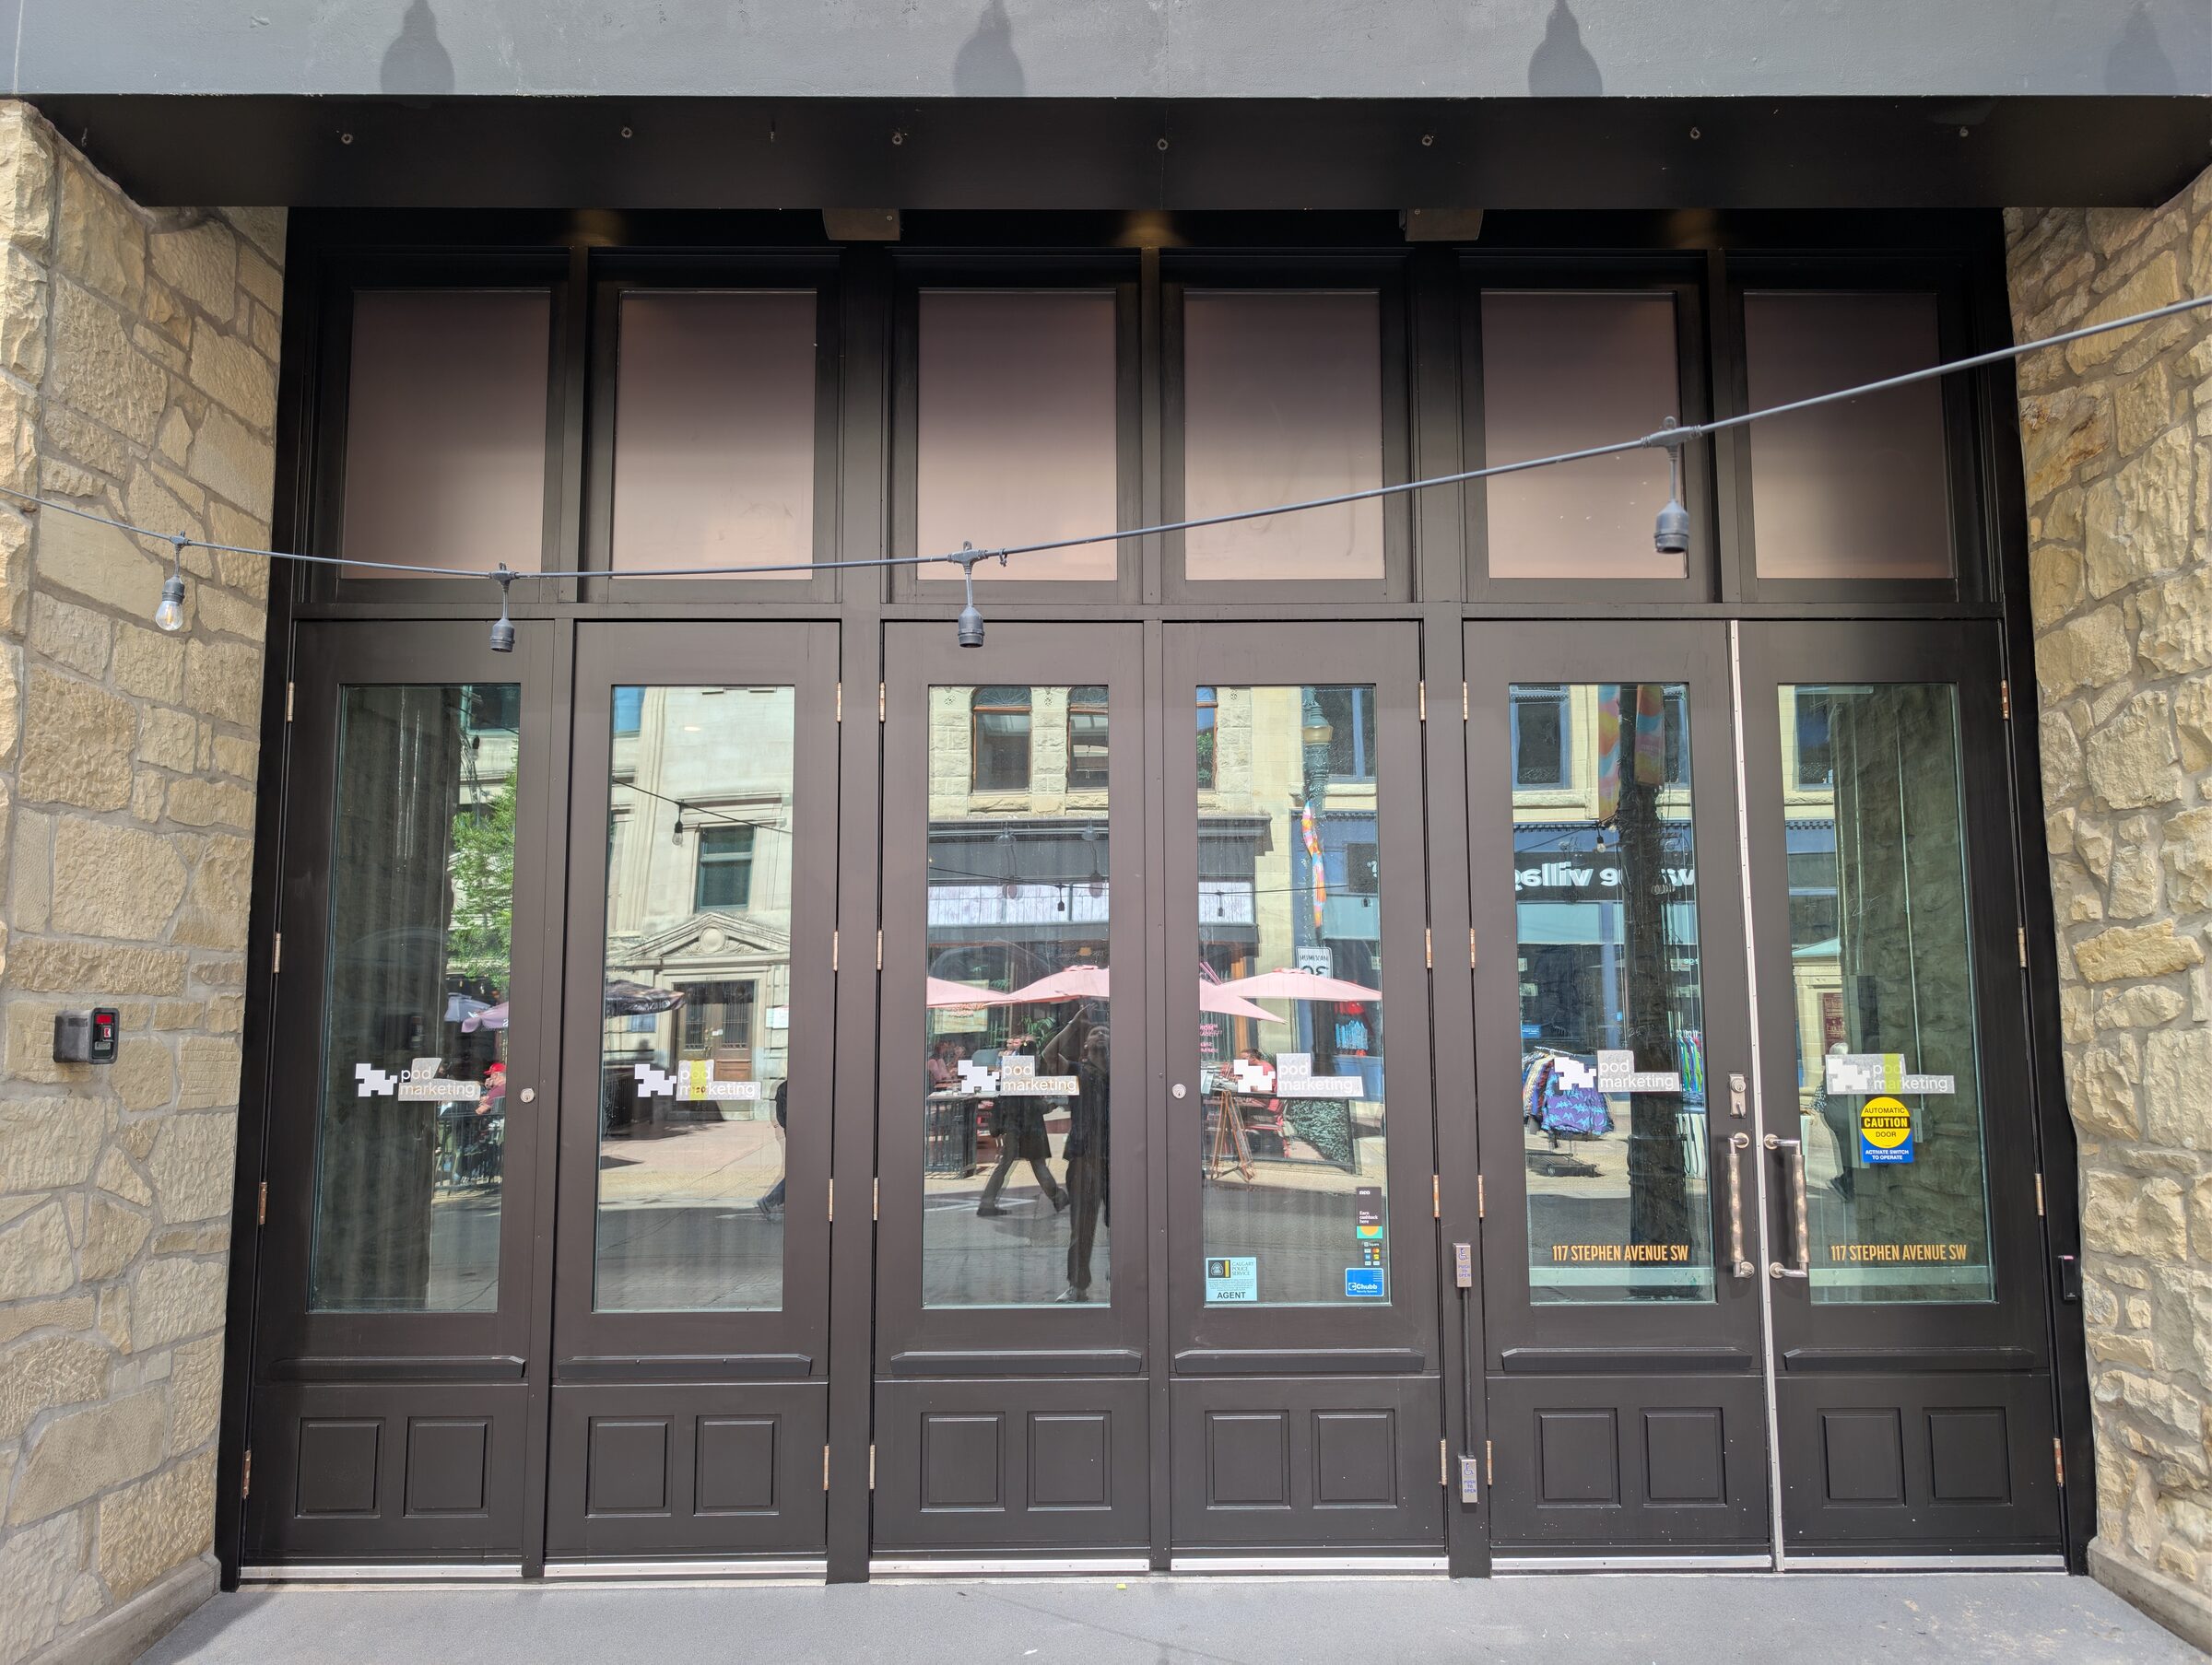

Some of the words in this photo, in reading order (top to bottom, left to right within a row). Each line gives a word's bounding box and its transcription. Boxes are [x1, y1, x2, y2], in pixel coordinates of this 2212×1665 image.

[401, 1066, 432, 1084] pod
[680, 1066, 712, 1083] pod
[1003, 1061, 1033, 1077] pod
[1279, 1061, 1309, 1077] pod
[1599, 1059, 1630, 1075] pod
[1873, 1060, 1903, 1077] pod
[400, 1082, 476, 1097] marketing
[679, 1082, 755, 1097] marketing
[1003, 1077, 1077, 1094] marketing
[1279, 1077, 1353, 1094] marketing
[1600, 1074, 1674, 1090] marketing
[1874, 1076, 1947, 1092] marketing
[1864, 1117, 1908, 1128] CAUTION
[1552, 1245, 1568, 1261] 117
[1571, 1245, 1621, 1261] STEPHEN
[1624, 1245, 1668, 1261] AVENUE
[1670, 1245, 1688, 1261] SW
[1831, 1245, 1846, 1261] 117
[1849, 1245, 1900, 1261] STEPHEN
[1902, 1244, 1947, 1260] AVENUE
[1948, 1244, 1967, 1260] SW
[1217, 1291, 1246, 1299] AGENT
